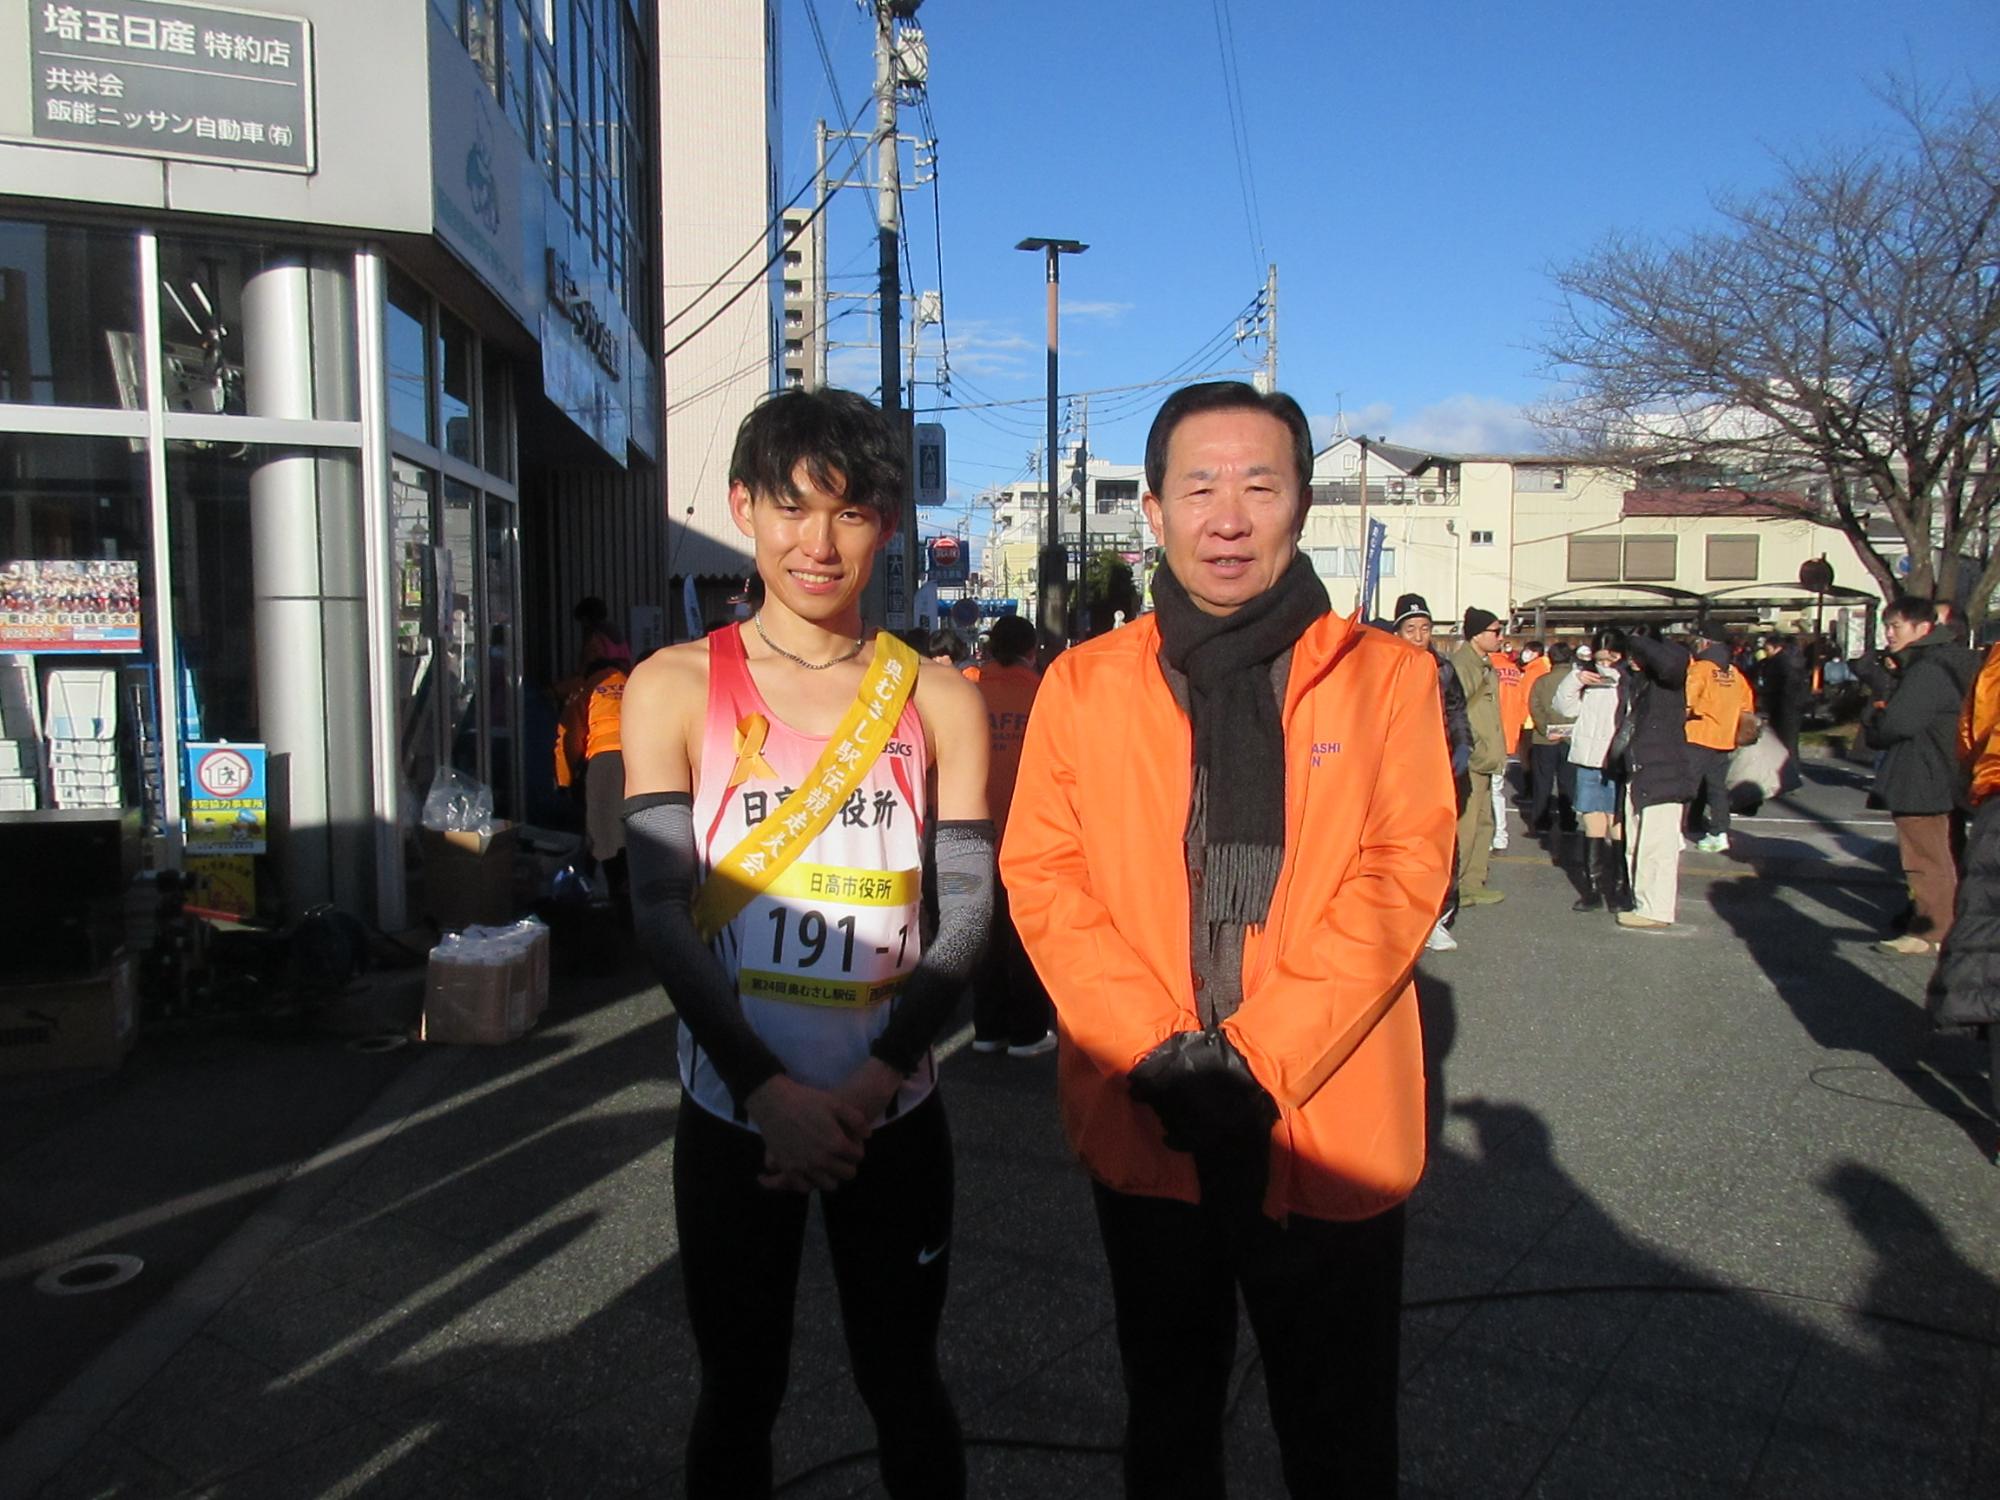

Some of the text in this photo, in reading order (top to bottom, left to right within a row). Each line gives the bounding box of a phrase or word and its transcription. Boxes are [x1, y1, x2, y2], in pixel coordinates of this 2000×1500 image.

[44, 4, 291, 68] 埼玉日産 特約店
[46, 67, 124, 98] 共栄会
[740, 657, 903, 877] 奥むさし駅伝競走大会
[743, 785, 898, 831] 日役所
[810, 872, 893, 900] 日高市役所
